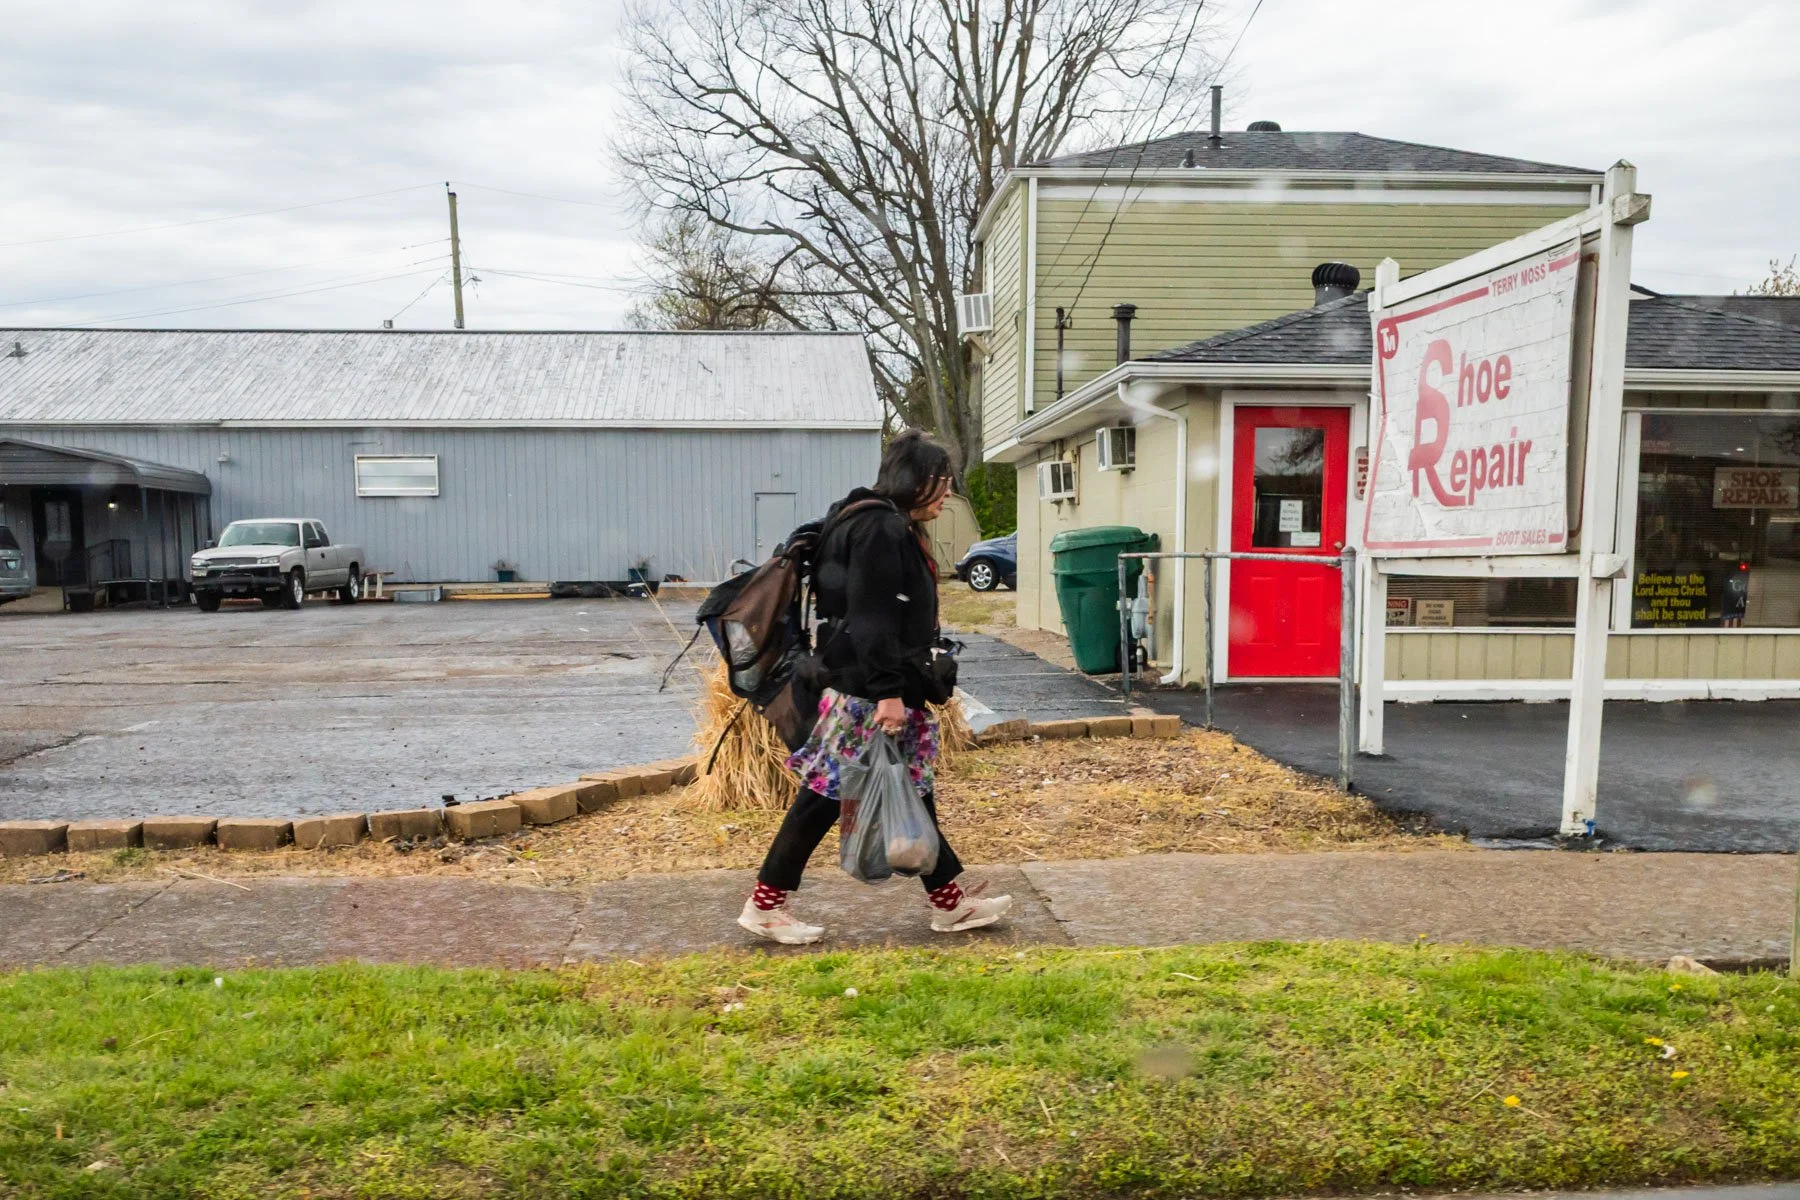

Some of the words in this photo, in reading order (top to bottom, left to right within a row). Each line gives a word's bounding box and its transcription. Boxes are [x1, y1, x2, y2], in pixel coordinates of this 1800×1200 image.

[1492, 273, 1518, 297] TERRY
[1521, 263, 1546, 286] MOSS
[1408, 339, 1512, 470] Shoe
[1408, 400, 1533, 507] Repair
[1731, 471, 1782, 487] SHOE
[1722, 488, 1789, 504] REPAIR
[1496, 530, 1520, 546] BOOT
[1521, 528, 1546, 545] SALES
[1638, 573, 1673, 585] Believe
[1674, 576, 1687, 585] on
[1689, 573, 1705, 585] the
[1635, 585, 1655, 597] Lord
[1655, 585, 1679, 597] Jesus
[1651, 598, 1668, 607] and
[1670, 597, 1691, 607] thou
[1635, 608, 1660, 620] shalt
[1662, 607, 1675, 620] be
[1677, 608, 1706, 620] saved
